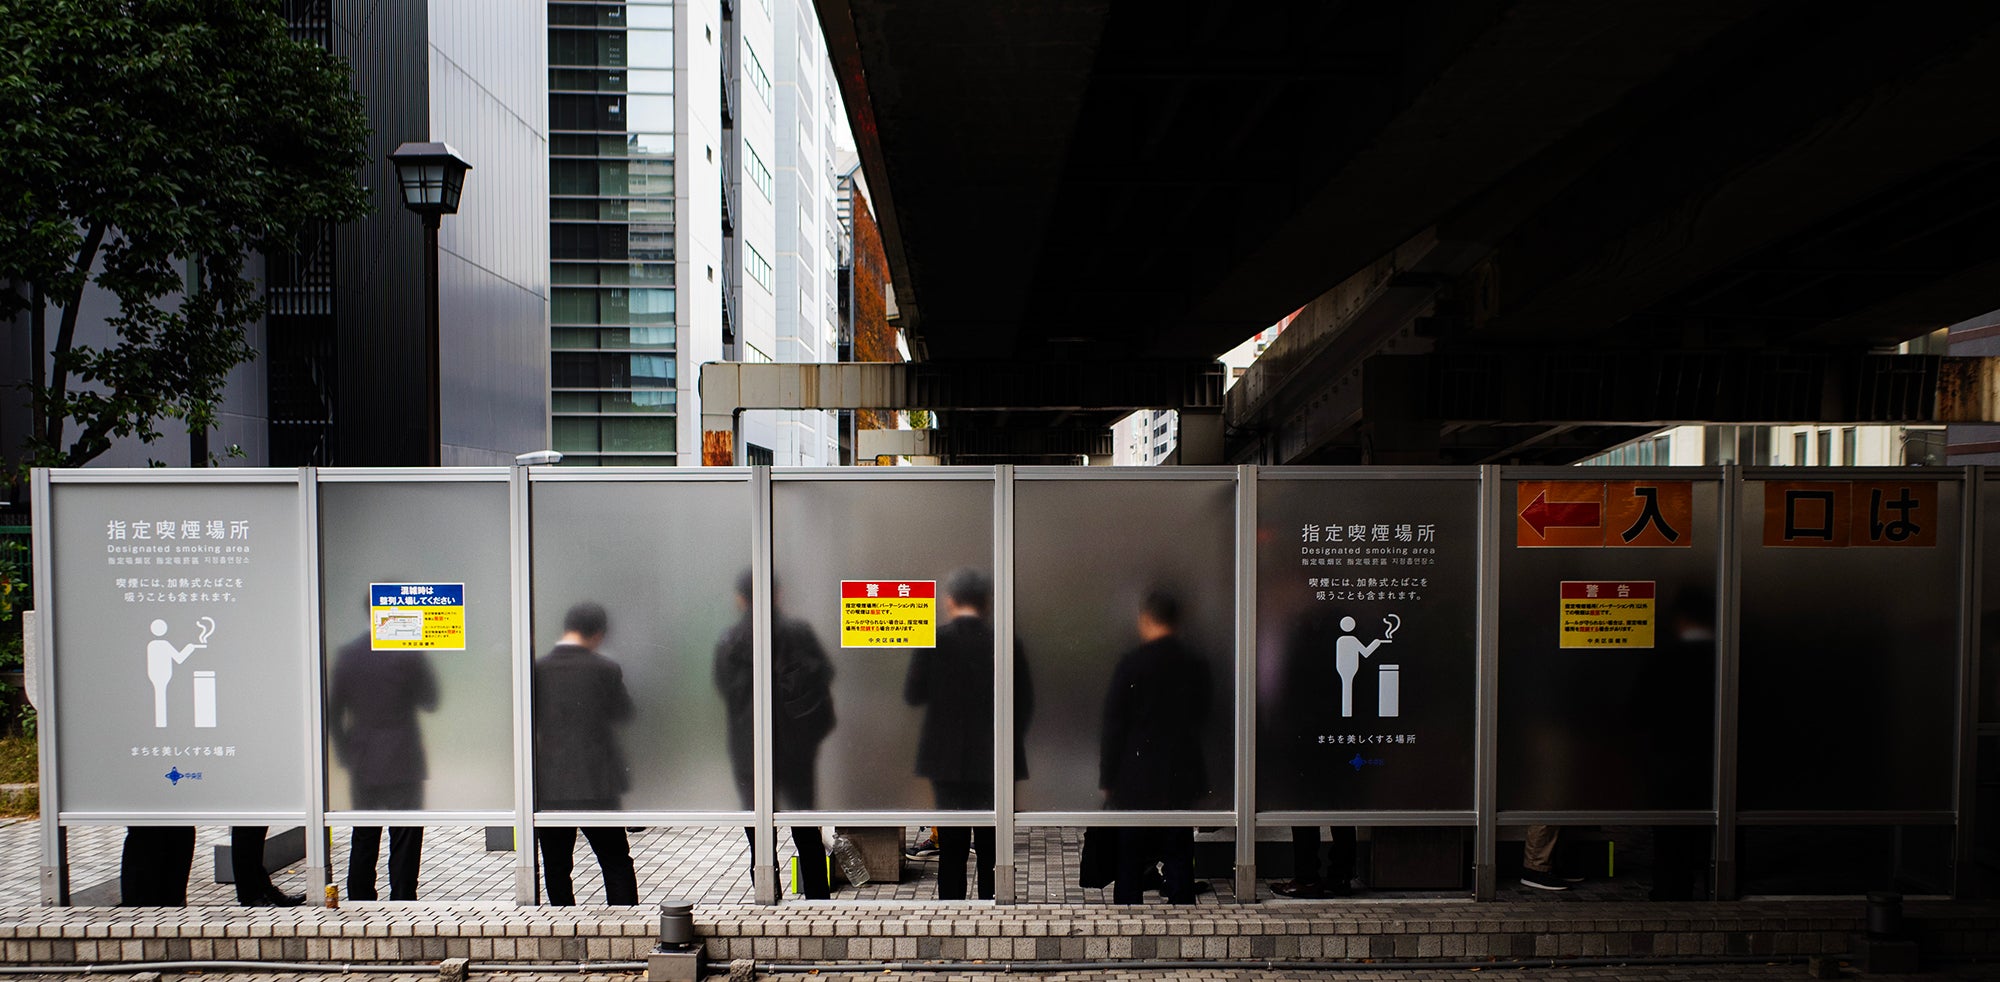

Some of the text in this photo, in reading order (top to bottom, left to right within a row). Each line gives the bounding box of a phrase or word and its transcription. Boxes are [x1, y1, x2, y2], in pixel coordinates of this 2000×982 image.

[107, 520, 249, 540] 指定喫煙場所
[1302, 524, 1435, 542] 指定喫煙場所
[107, 544, 250, 554] Designated smoking area
[1301, 547, 1360, 555] Designated
[1366, 547, 1408, 555] smoking
[116, 577, 243, 589] 喫煙には、加熱式たばこを
[1308, 578, 1428, 587] 喫煙には、加熱式たばこを
[866, 583, 911, 597] 警告
[1586, 584, 1630, 597] 警告
[124, 592, 237, 602] 吸うことも含まれます。
[380, 596, 456, 605] 整列入場してください
[1316, 591, 1421, 600] 吸うことも含まれます。
[1318, 734, 1416, 744] まちを美しくする場所
[131, 746, 236, 756] まちを美しくする場所
